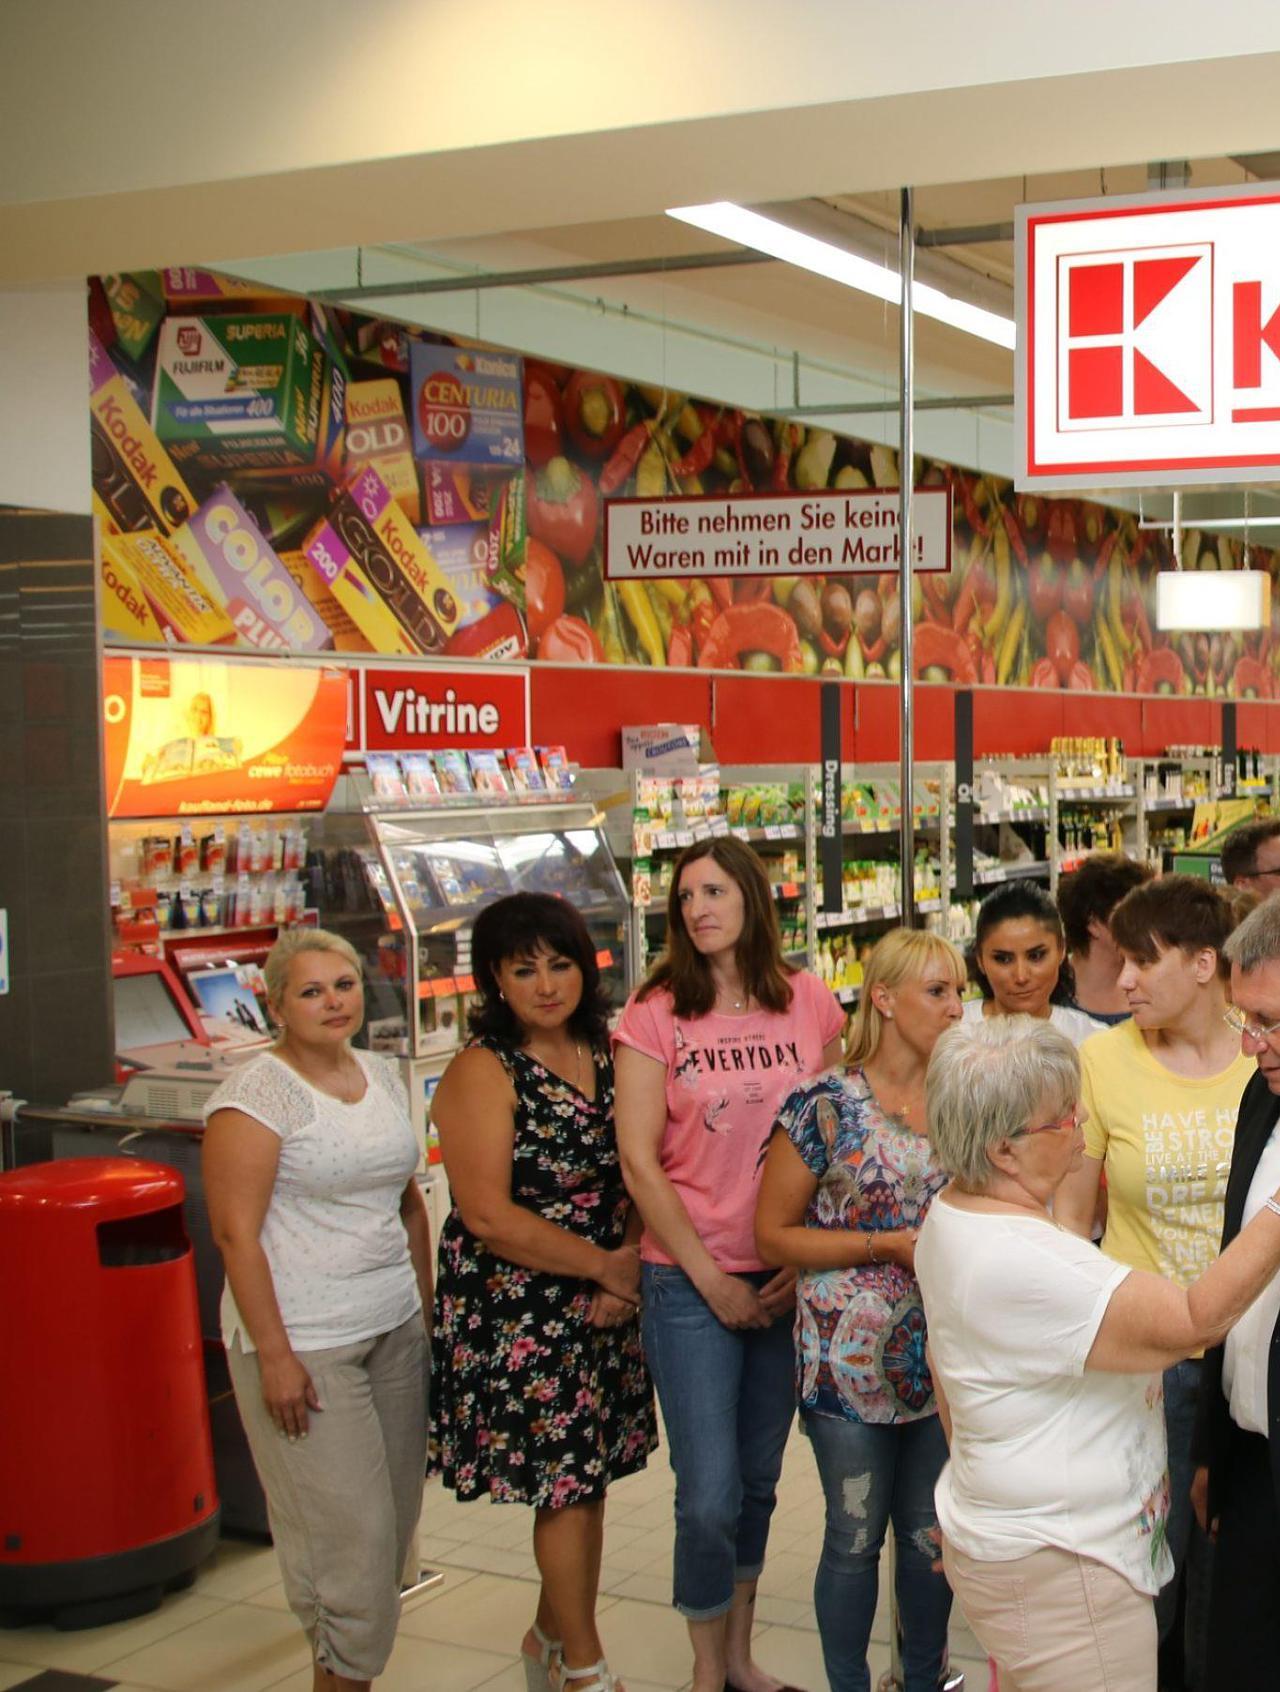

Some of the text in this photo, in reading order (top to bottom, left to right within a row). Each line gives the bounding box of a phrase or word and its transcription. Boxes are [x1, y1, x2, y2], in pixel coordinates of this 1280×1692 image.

[226, 323, 286, 340] SUPERIA
[173, 360, 225, 374] FUJIFILM
[350, 395, 400, 417] Kodak
[424, 380, 518, 410] CENTURIA
[426, 411, 467, 438] 100
[98, 394, 159, 490] Kodak
[641, 509, 690, 536] Bitte
[697, 504, 791, 534] nehmen
[801, 502, 836, 530] Sie
[311, 542, 339, 579] 200
[380, 517, 429, 593] Kodak
[627, 535, 924, 570] Waren mit in den Mark!
[205, 504, 315, 650] COLOR
[337, 510, 446, 652] GOLD
[374, 688, 500, 734] Vitrine
[823, 759, 839, 838] Dressing
[689, 1042, 800, 1072] EVERYDAY
[1142, 1110, 1207, 1131] HAVE
[1145, 1152, 1172, 1166] LIVE
